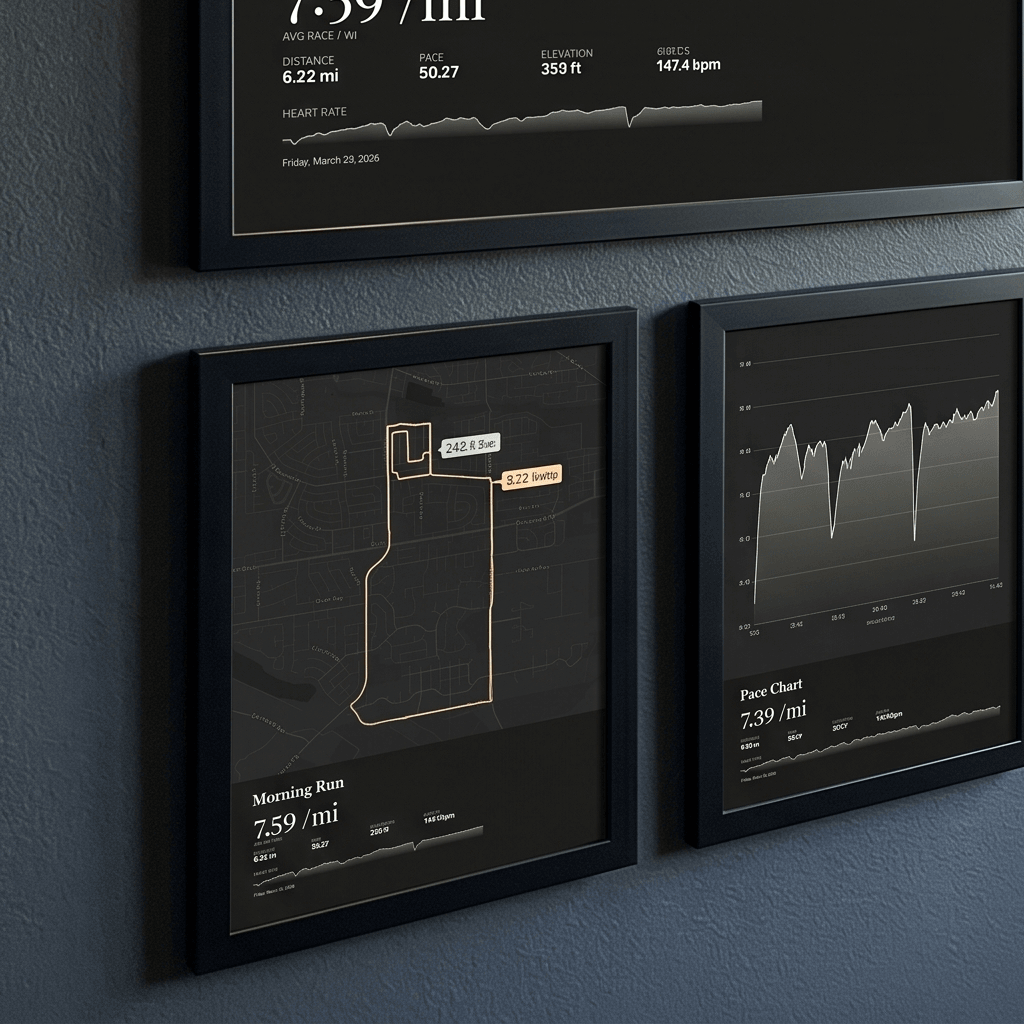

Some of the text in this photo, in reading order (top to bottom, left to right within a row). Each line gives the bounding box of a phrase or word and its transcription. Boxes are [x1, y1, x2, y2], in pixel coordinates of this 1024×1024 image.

[282, 31, 305, 41] AVG
[307, 30, 335, 40] RACE
[419, 52, 444, 62] PACE
[541, 48, 594, 58] ELEVATION
[282, 55, 335, 66] DISTANCE
[569, 60, 582, 74] ft
[656, 58, 721, 73] 147.4 bpm
[282, 68, 339, 83] 6.22 mi
[419, 65, 460, 79] 50.27
[282, 106, 348, 118] HEART RATE
[313, 156, 341, 165] March
[358, 153, 380, 162] 2026
[740, 678, 803, 702] Pace Chart
[740, 699, 807, 730] 7.39 /mi
[252, 776, 345, 807] Morning Run
[253, 801, 339, 839] 7.59 /mi
